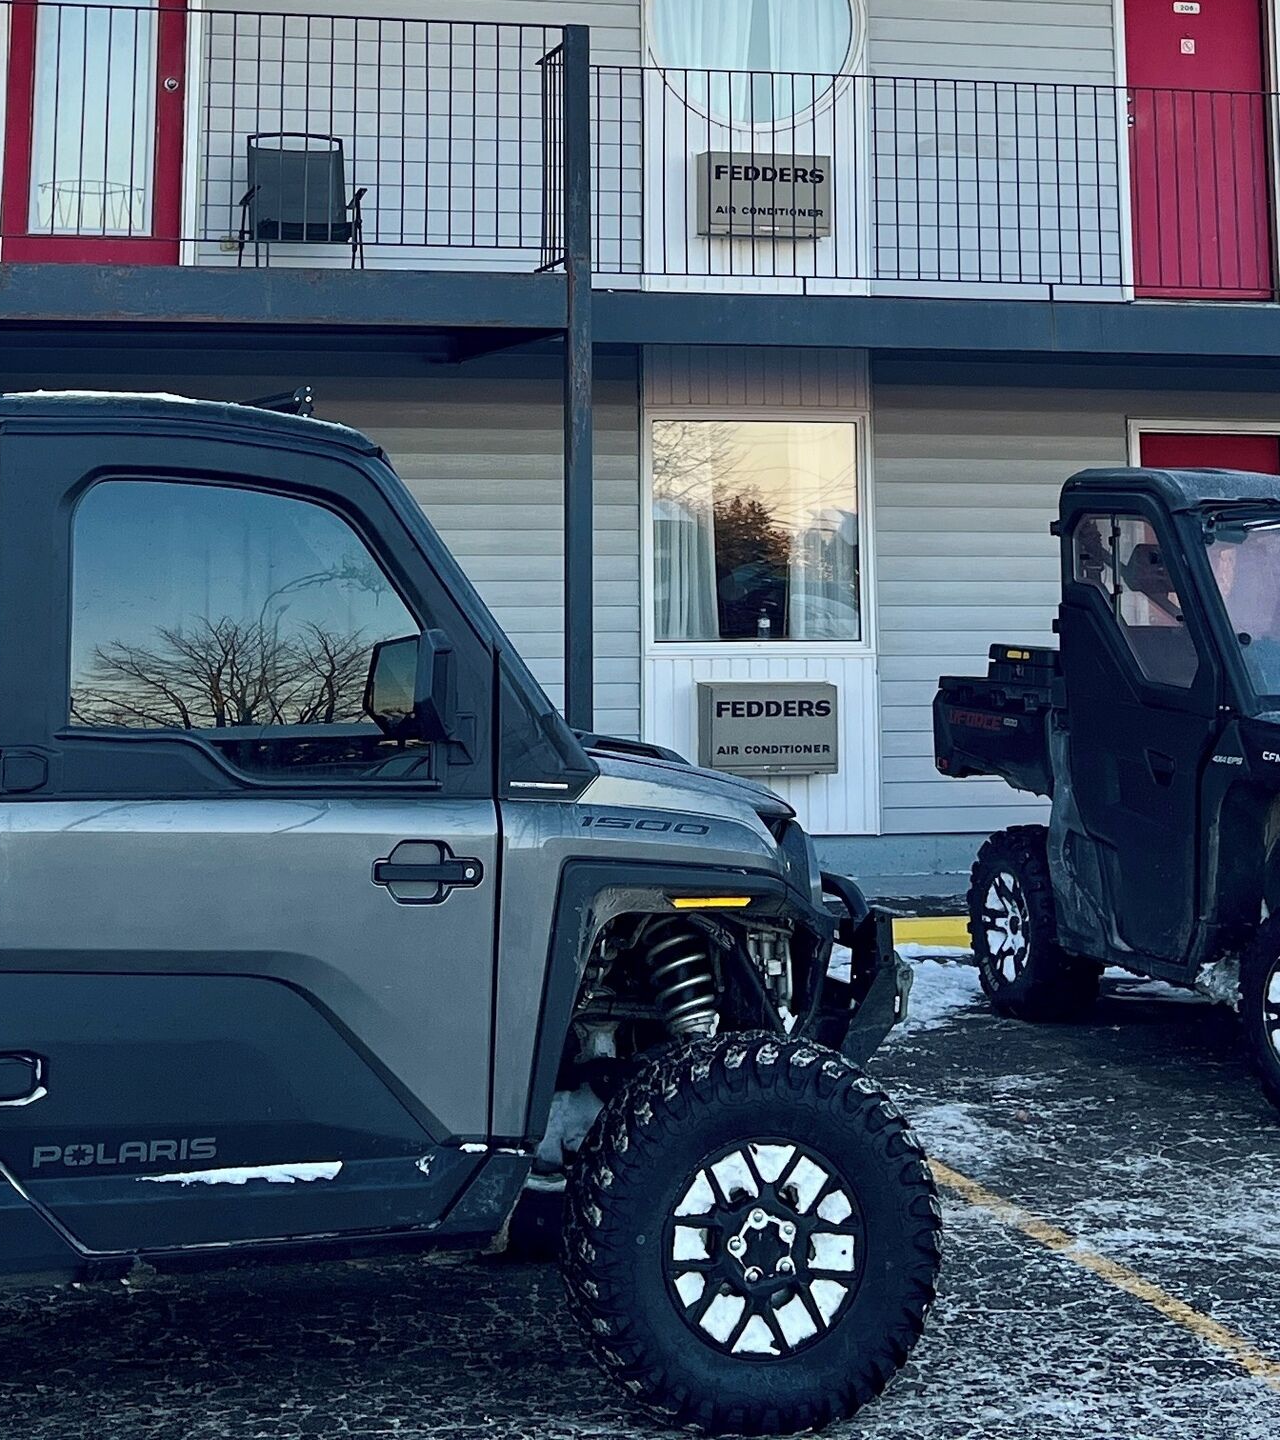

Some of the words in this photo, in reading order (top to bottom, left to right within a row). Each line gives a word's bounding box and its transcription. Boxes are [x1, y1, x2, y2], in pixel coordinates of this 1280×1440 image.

[715, 165, 825, 184] FEDDERS
[715, 205, 736, 214] AIR
[741, 206, 824, 217] CONDITIONER
[716, 700, 832, 718] FEDDERS
[717, 745, 739, 755] AIR
[744, 744, 830, 755] CONDITIONER
[581, 815, 709, 835] 1500
[32, 1137, 216, 1168] POLARIS
